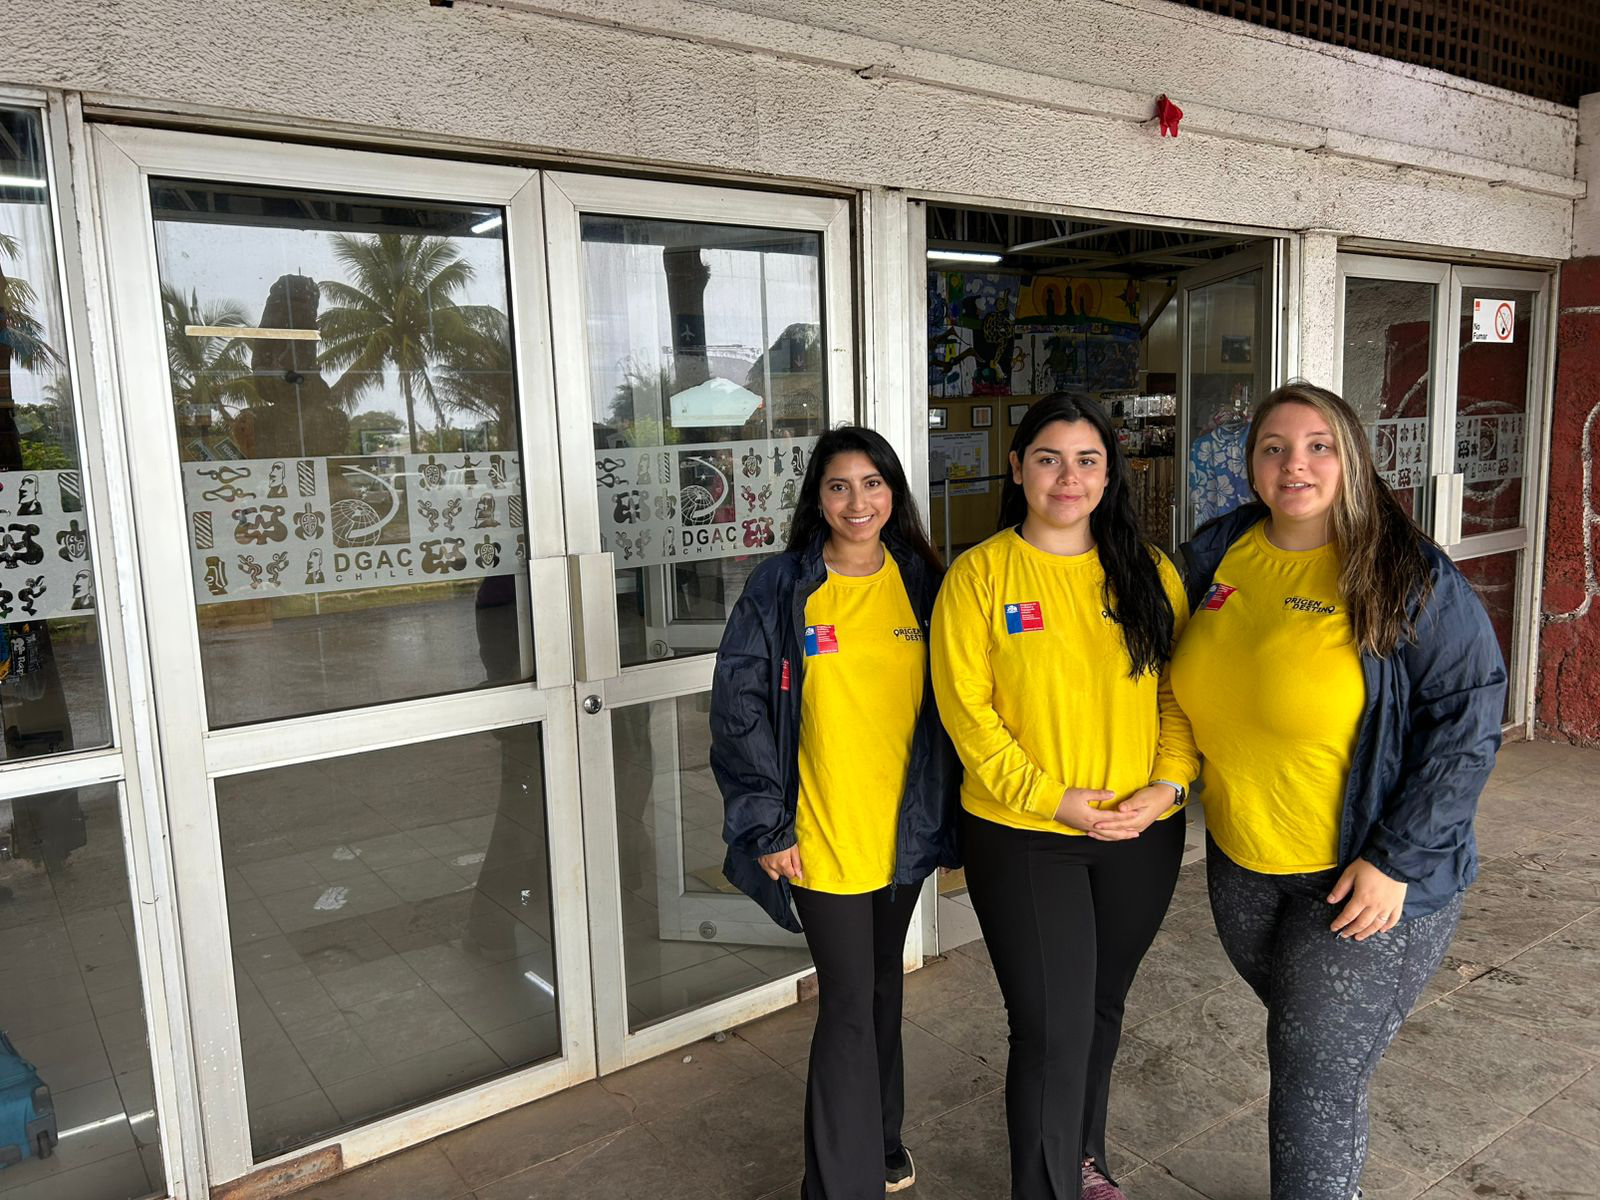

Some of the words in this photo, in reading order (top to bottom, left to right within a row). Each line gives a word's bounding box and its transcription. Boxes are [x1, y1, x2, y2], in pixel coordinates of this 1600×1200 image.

[1478, 462, 1497, 473] DGAC
[682, 526, 737, 546] DGAC
[334, 548, 413, 573] DGAC
[336, 568, 414, 583] CHILE
[1285, 597, 1322, 607] ORIGEN
[1292, 603, 1336, 614] DESTINO
